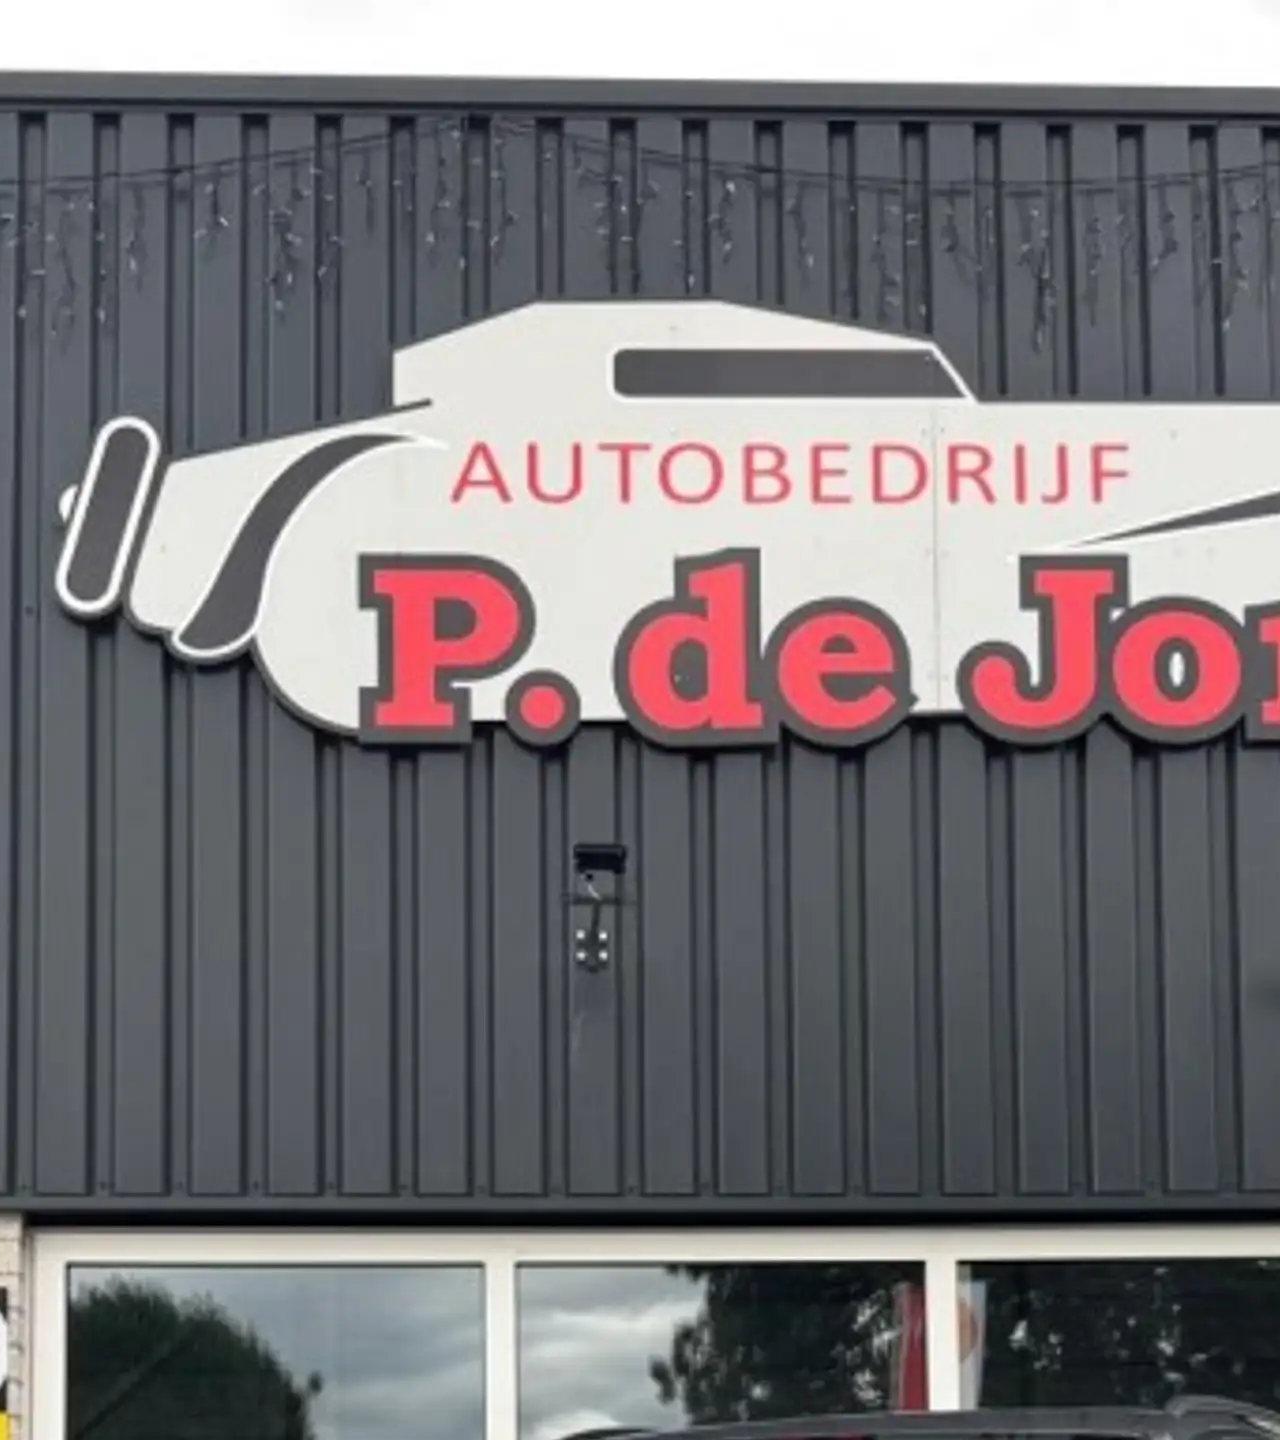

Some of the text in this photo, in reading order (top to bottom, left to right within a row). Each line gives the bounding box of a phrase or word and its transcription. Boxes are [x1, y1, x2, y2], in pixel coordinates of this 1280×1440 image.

[451, 442, 1132, 504] AUTOBEDRIJF
[368, 562, 568, 734] P.
[623, 560, 898, 734] de
